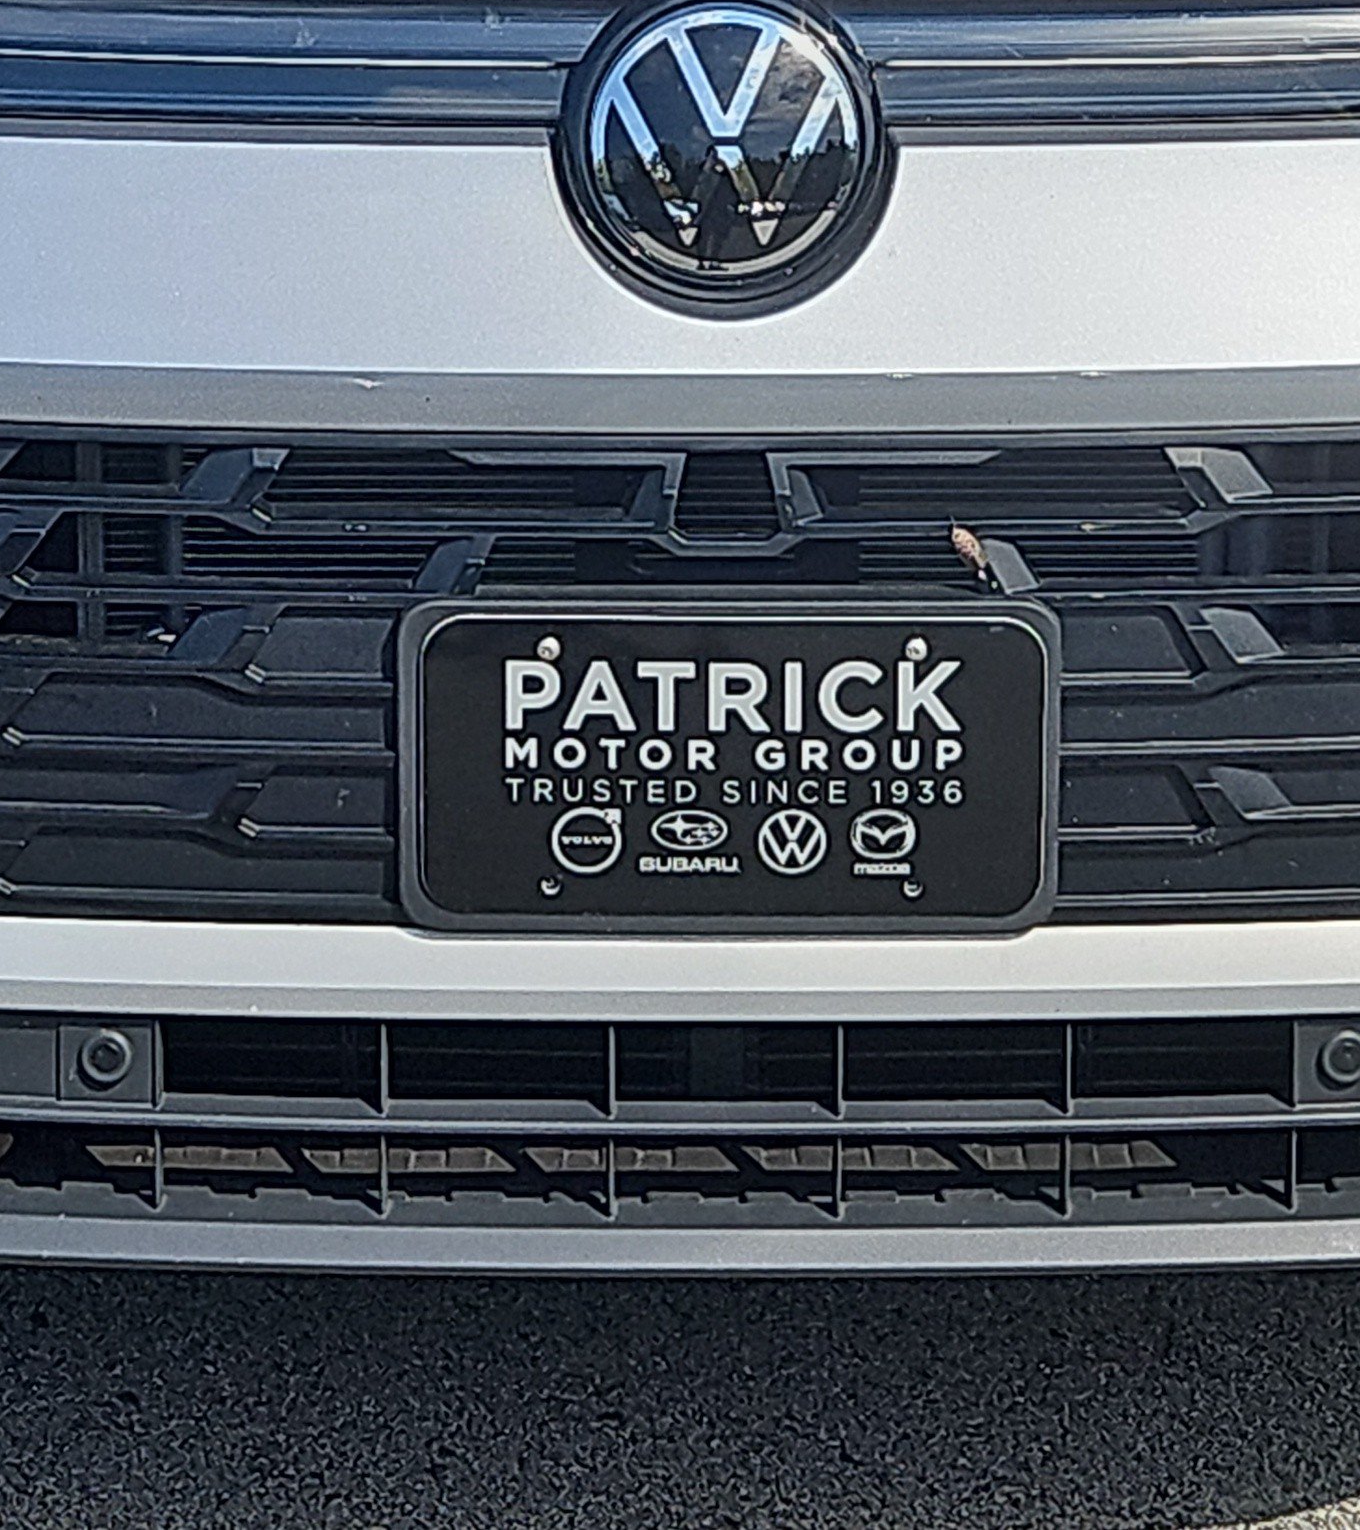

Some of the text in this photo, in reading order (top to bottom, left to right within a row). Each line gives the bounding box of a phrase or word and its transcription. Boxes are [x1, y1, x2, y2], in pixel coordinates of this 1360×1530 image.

[505, 661, 962, 733] PATRICK
[505, 738, 964, 771] MOTOR GROUP
[506, 778, 963, 805] TRUSTED SINCE 1936
[560, 835, 613, 845] VOLVO
[639, 856, 740, 873] SUBARU
